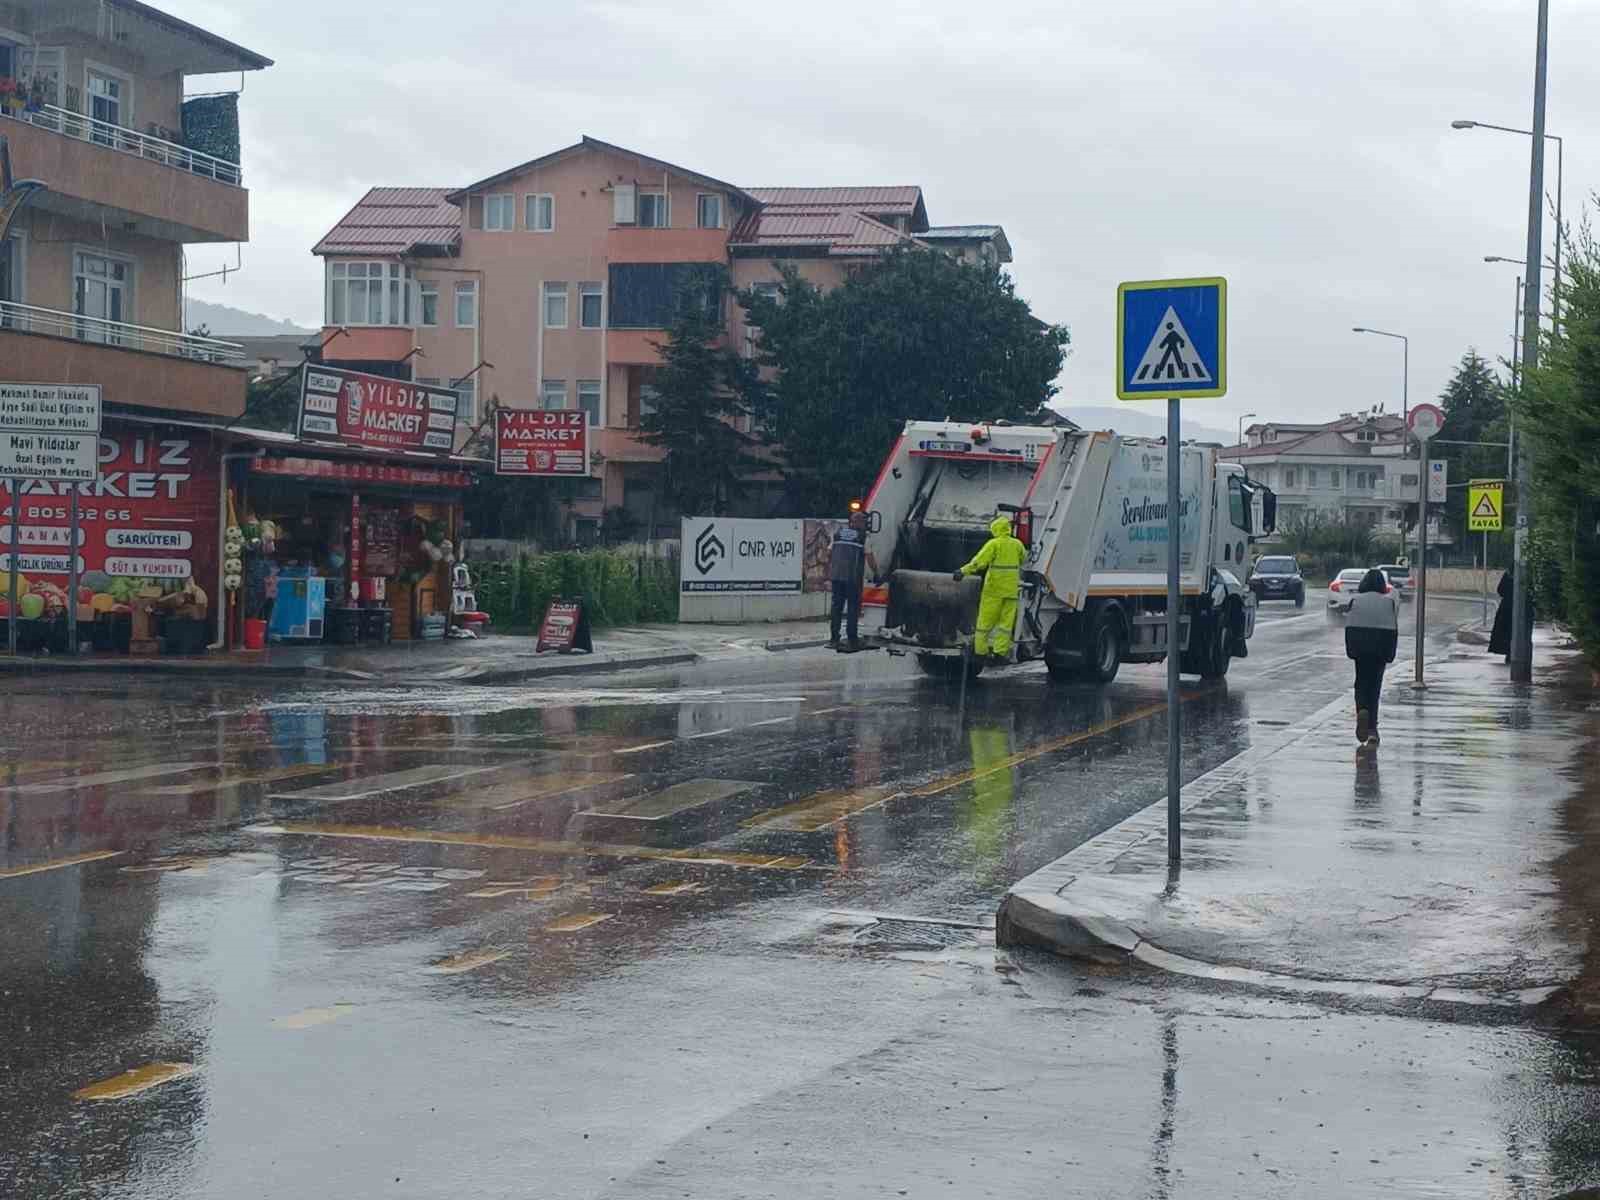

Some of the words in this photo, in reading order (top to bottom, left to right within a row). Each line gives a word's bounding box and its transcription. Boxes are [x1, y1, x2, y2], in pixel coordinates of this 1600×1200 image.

[367, 382, 426, 411] YILDIZ
[60, 403, 84, 415] Eğitim
[87, 406, 95, 414] ve
[58, 417, 89, 428] Merkezi
[364, 408, 422, 434] MARKET
[503, 412, 581, 425] YILDIZ
[502, 428, 581, 440] MARKET
[10, 435, 34, 449] Mavi
[39, 436, 80, 450] Yıldızlar
[16, 451, 33, 463] Özel
[36, 454, 63, 466] Eğitim
[65, 457, 75, 465] ve
[97, 438, 191, 465] DIZ
[28, 506, 67, 519] 805
[104, 509, 131, 520] 66
[738, 540, 766, 557] CNR
[769, 540, 796, 557] YAPI
[6, 558, 39, 570] TMİZLİK
[111, 560, 128, 573] SÜT
[132, 563, 138, 573] &
[142, 562, 184, 575] YUMURTA
